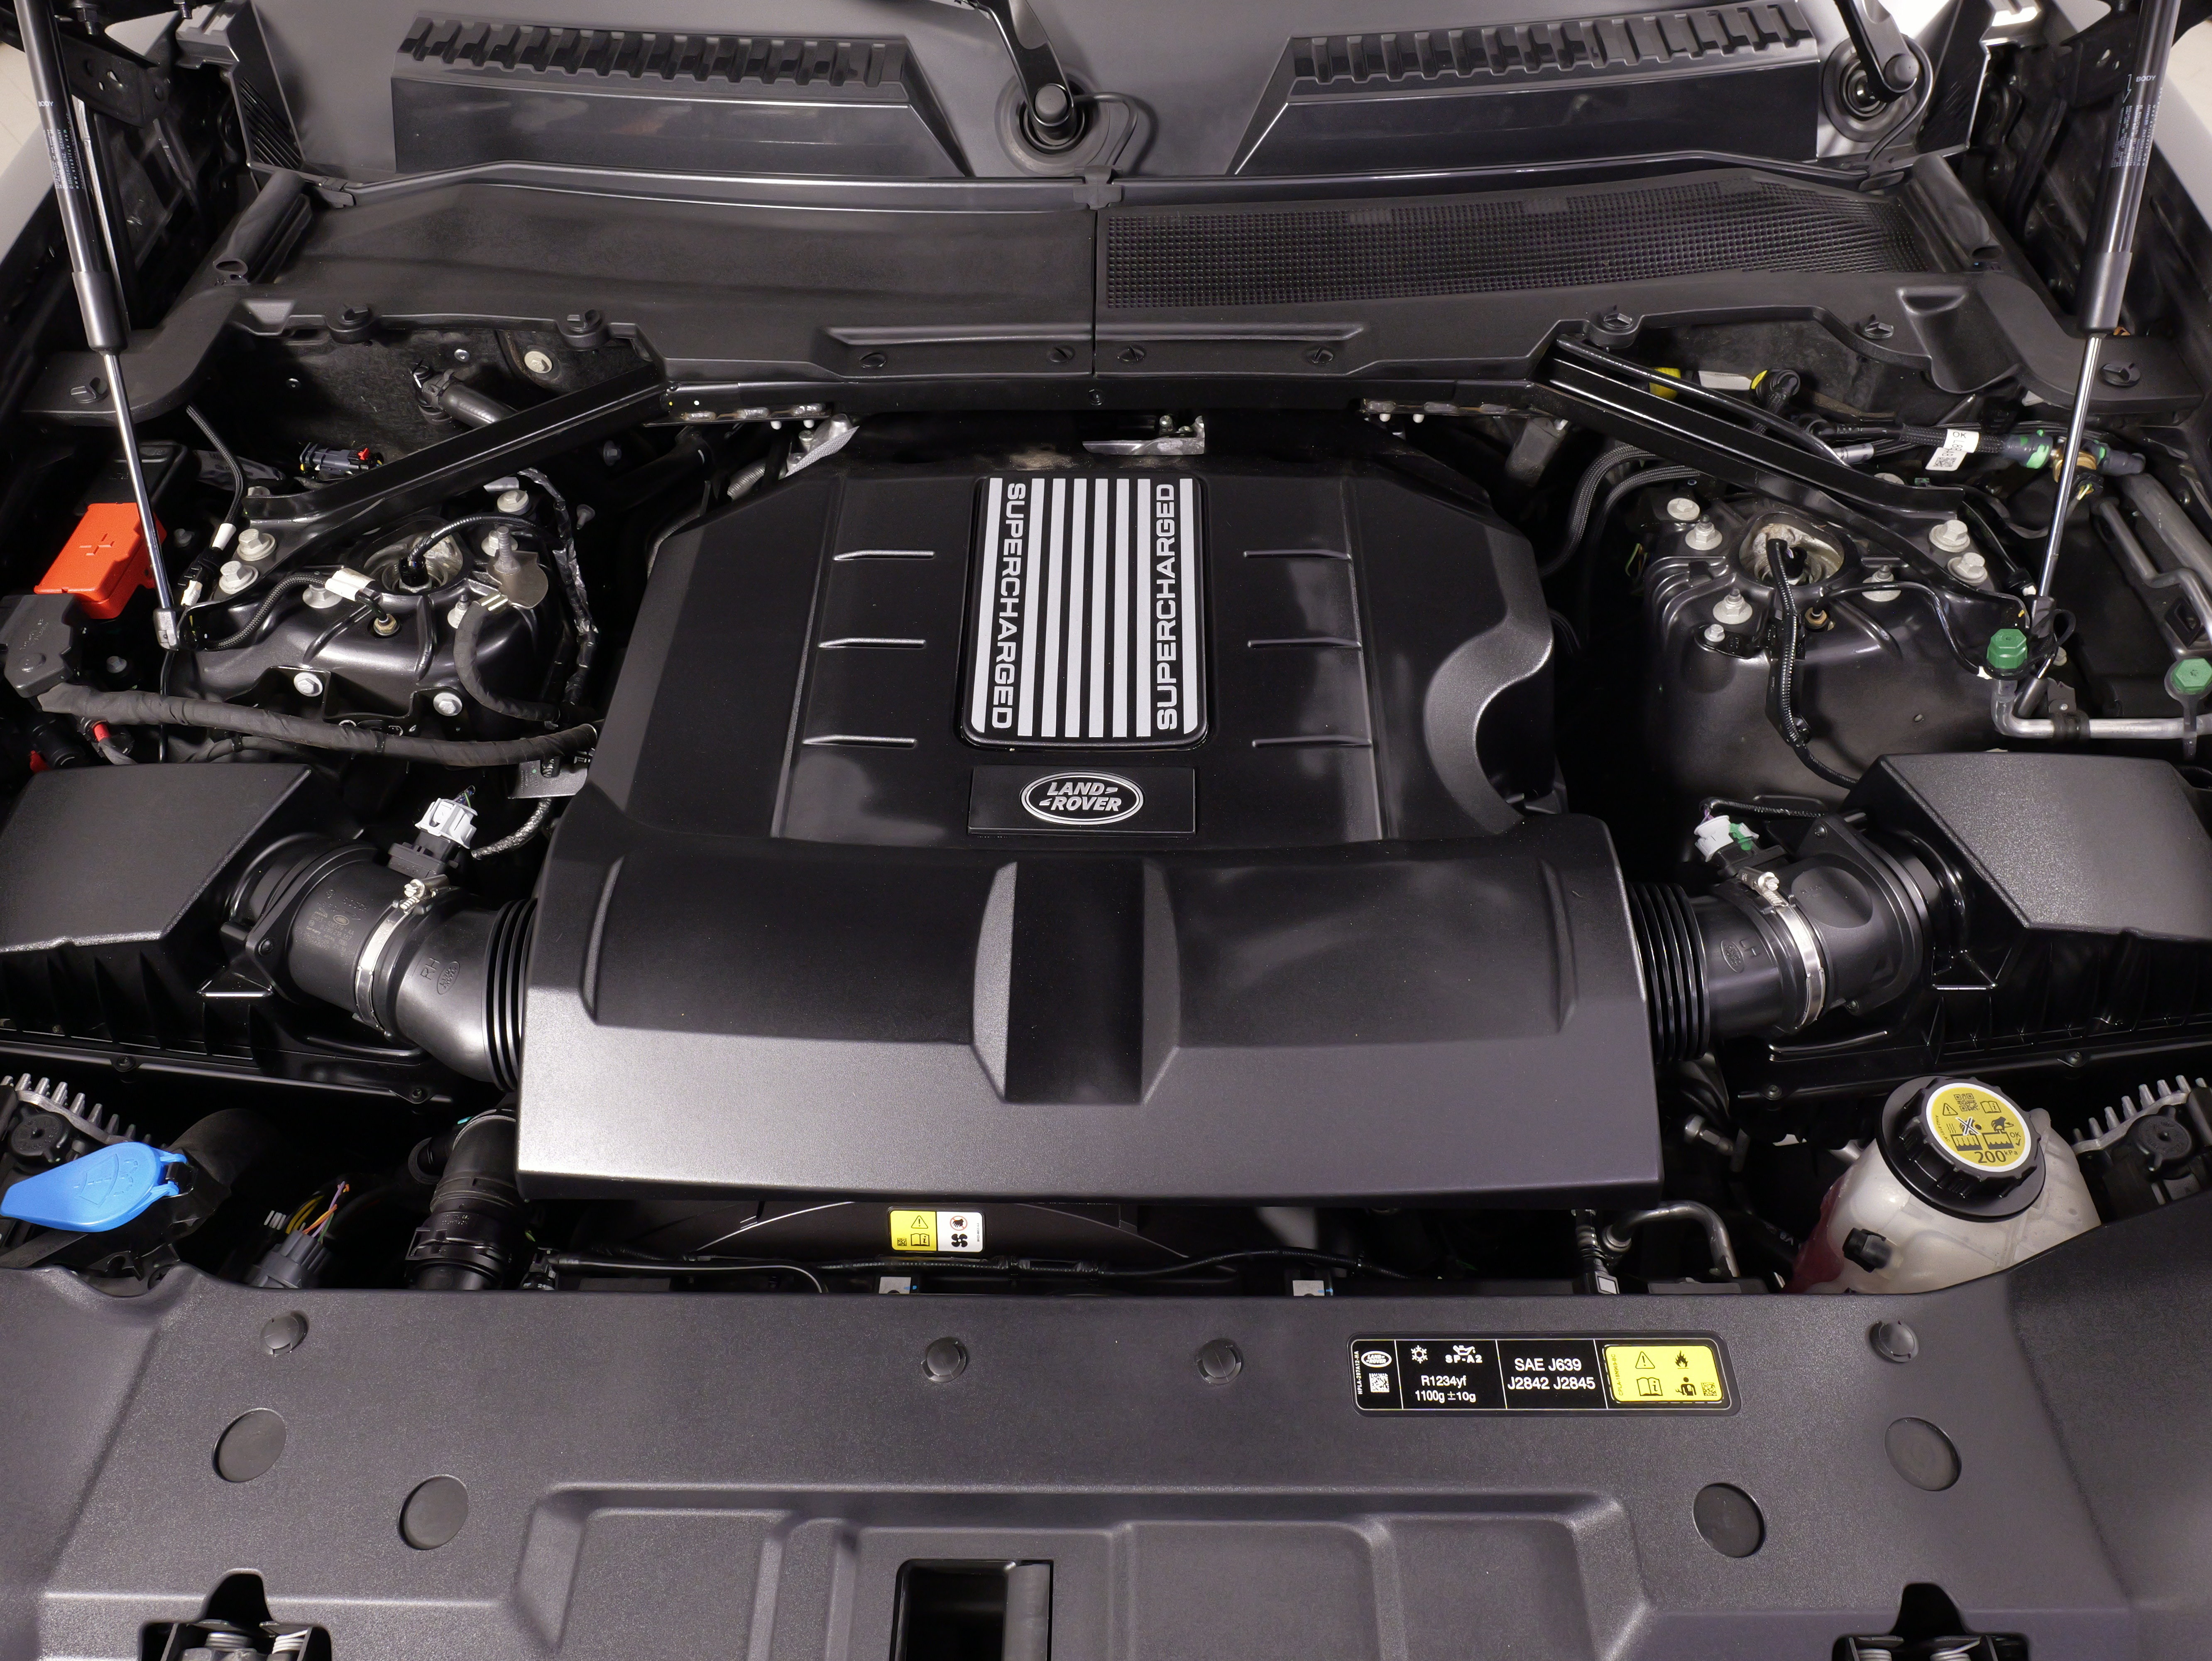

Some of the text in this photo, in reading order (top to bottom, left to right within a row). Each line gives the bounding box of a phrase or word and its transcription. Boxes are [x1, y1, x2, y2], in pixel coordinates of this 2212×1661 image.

[57, 129, 65, 150] GERMANY
[992, 483, 1026, 729] SUPERCHARGED
[1156, 484, 1178, 730] SUPERCHARGED
[1047, 782, 1105, 796] LAND
[1050, 796, 1122, 812] ROVER
[1740, 938, 1762, 958] LH
[420, 957, 441, 980] RH
[1975, 1150, 2006, 1164] 200
[1445, 1355, 1483, 1364] SP-A2
[1515, 1358, 1582, 1371] SAE J639
[1421, 1375, 1467, 1389] R1234yf
[1507, 1377, 1595, 1390] J2842 J2845
[1415, 1390, 1445, 1403] 1100g
